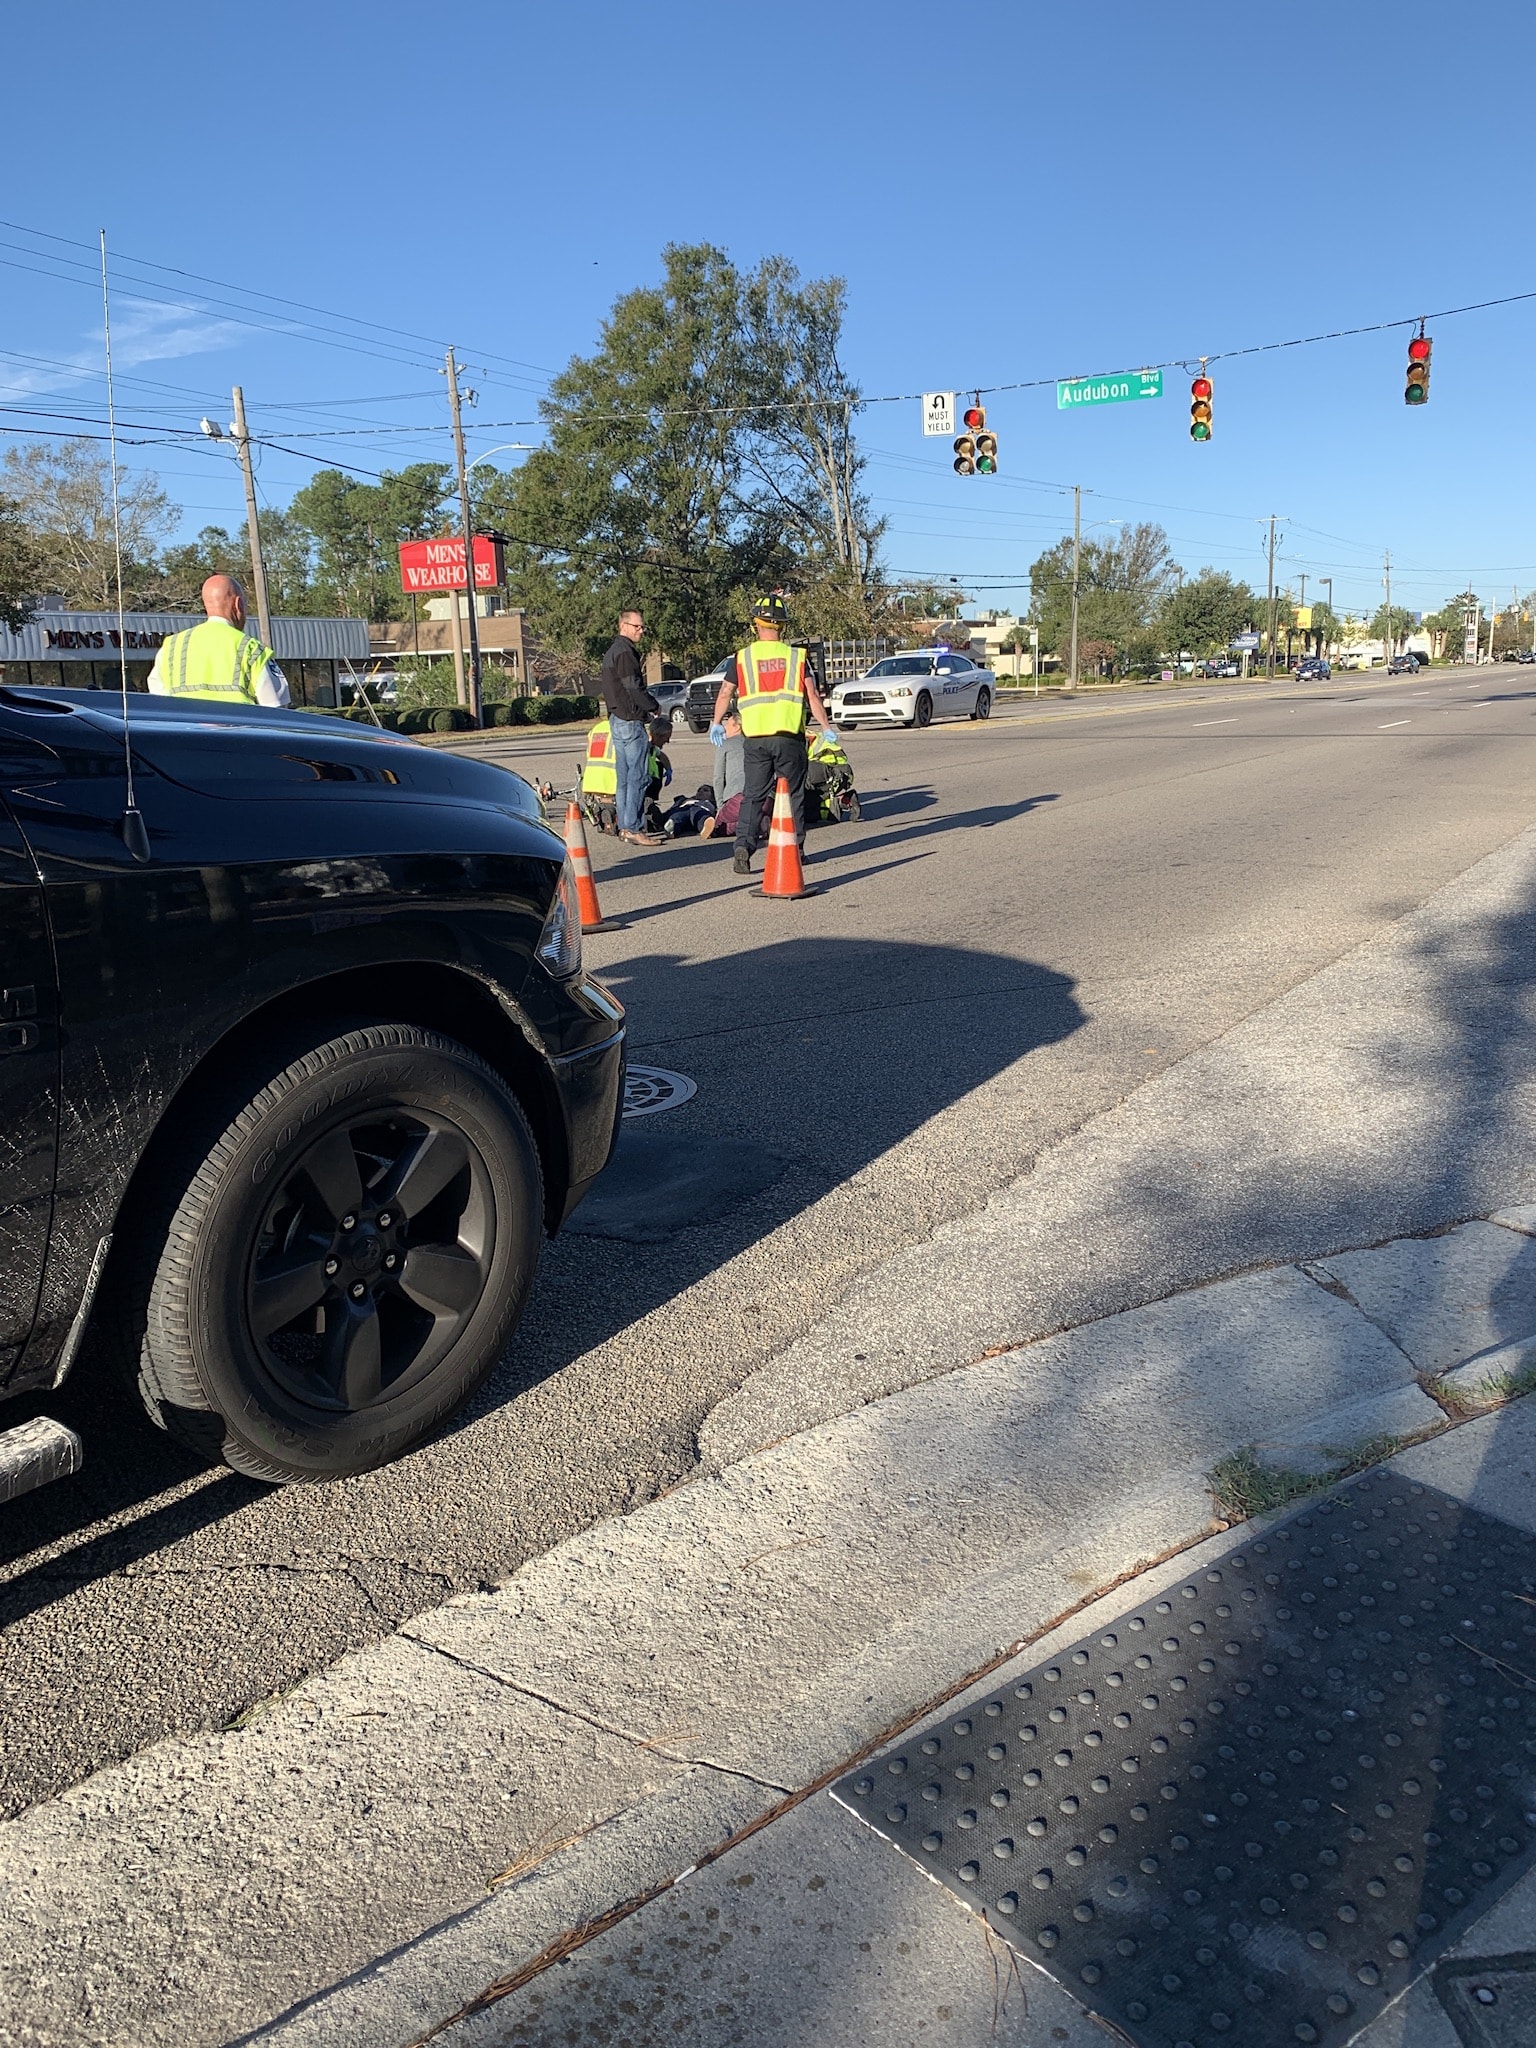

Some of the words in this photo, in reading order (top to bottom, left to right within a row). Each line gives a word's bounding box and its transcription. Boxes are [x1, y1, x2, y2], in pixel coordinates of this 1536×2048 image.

[1141, 372, 1160, 384] Blvd
[1061, 381, 1129, 404] Audubon
[928, 411, 949, 421] MUST
[927, 422, 951, 432] YIELD
[426, 543, 467, 565] MEN'S
[406, 563, 492, 587] WEARHOSE
[43, 629, 105, 649] MEN'S
[758, 658, 786, 673] FIRE
[251, 1065, 487, 1184] GOODYEAR
